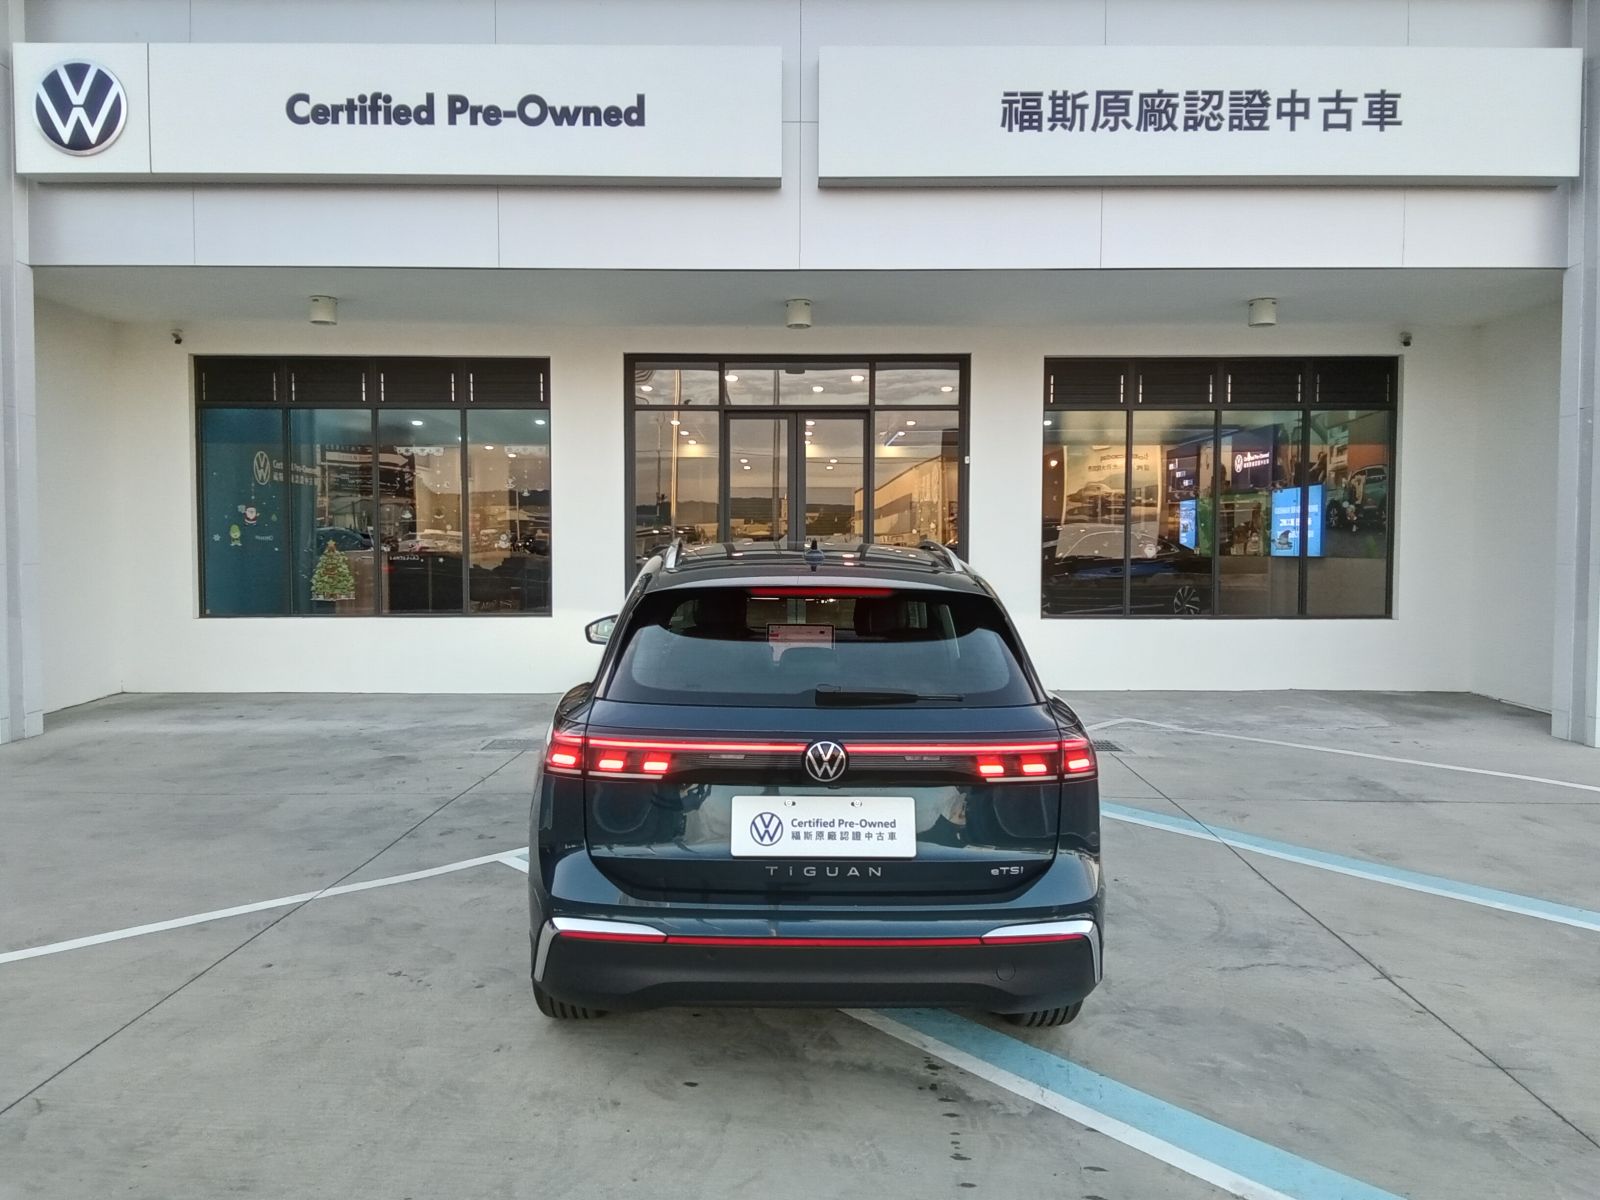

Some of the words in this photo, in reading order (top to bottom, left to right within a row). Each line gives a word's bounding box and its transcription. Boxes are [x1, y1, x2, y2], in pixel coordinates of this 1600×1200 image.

[286, 93, 434, 126] Certified
[448, 94, 646, 128] Pre-Owned
[1000, 88, 1404, 133] 福斯原廠認證中古車
[791, 818, 835, 828] Certified
[838, 819, 897, 828] Pre-Owned
[791, 831, 897, 841] 福斯原廠認證中古車
